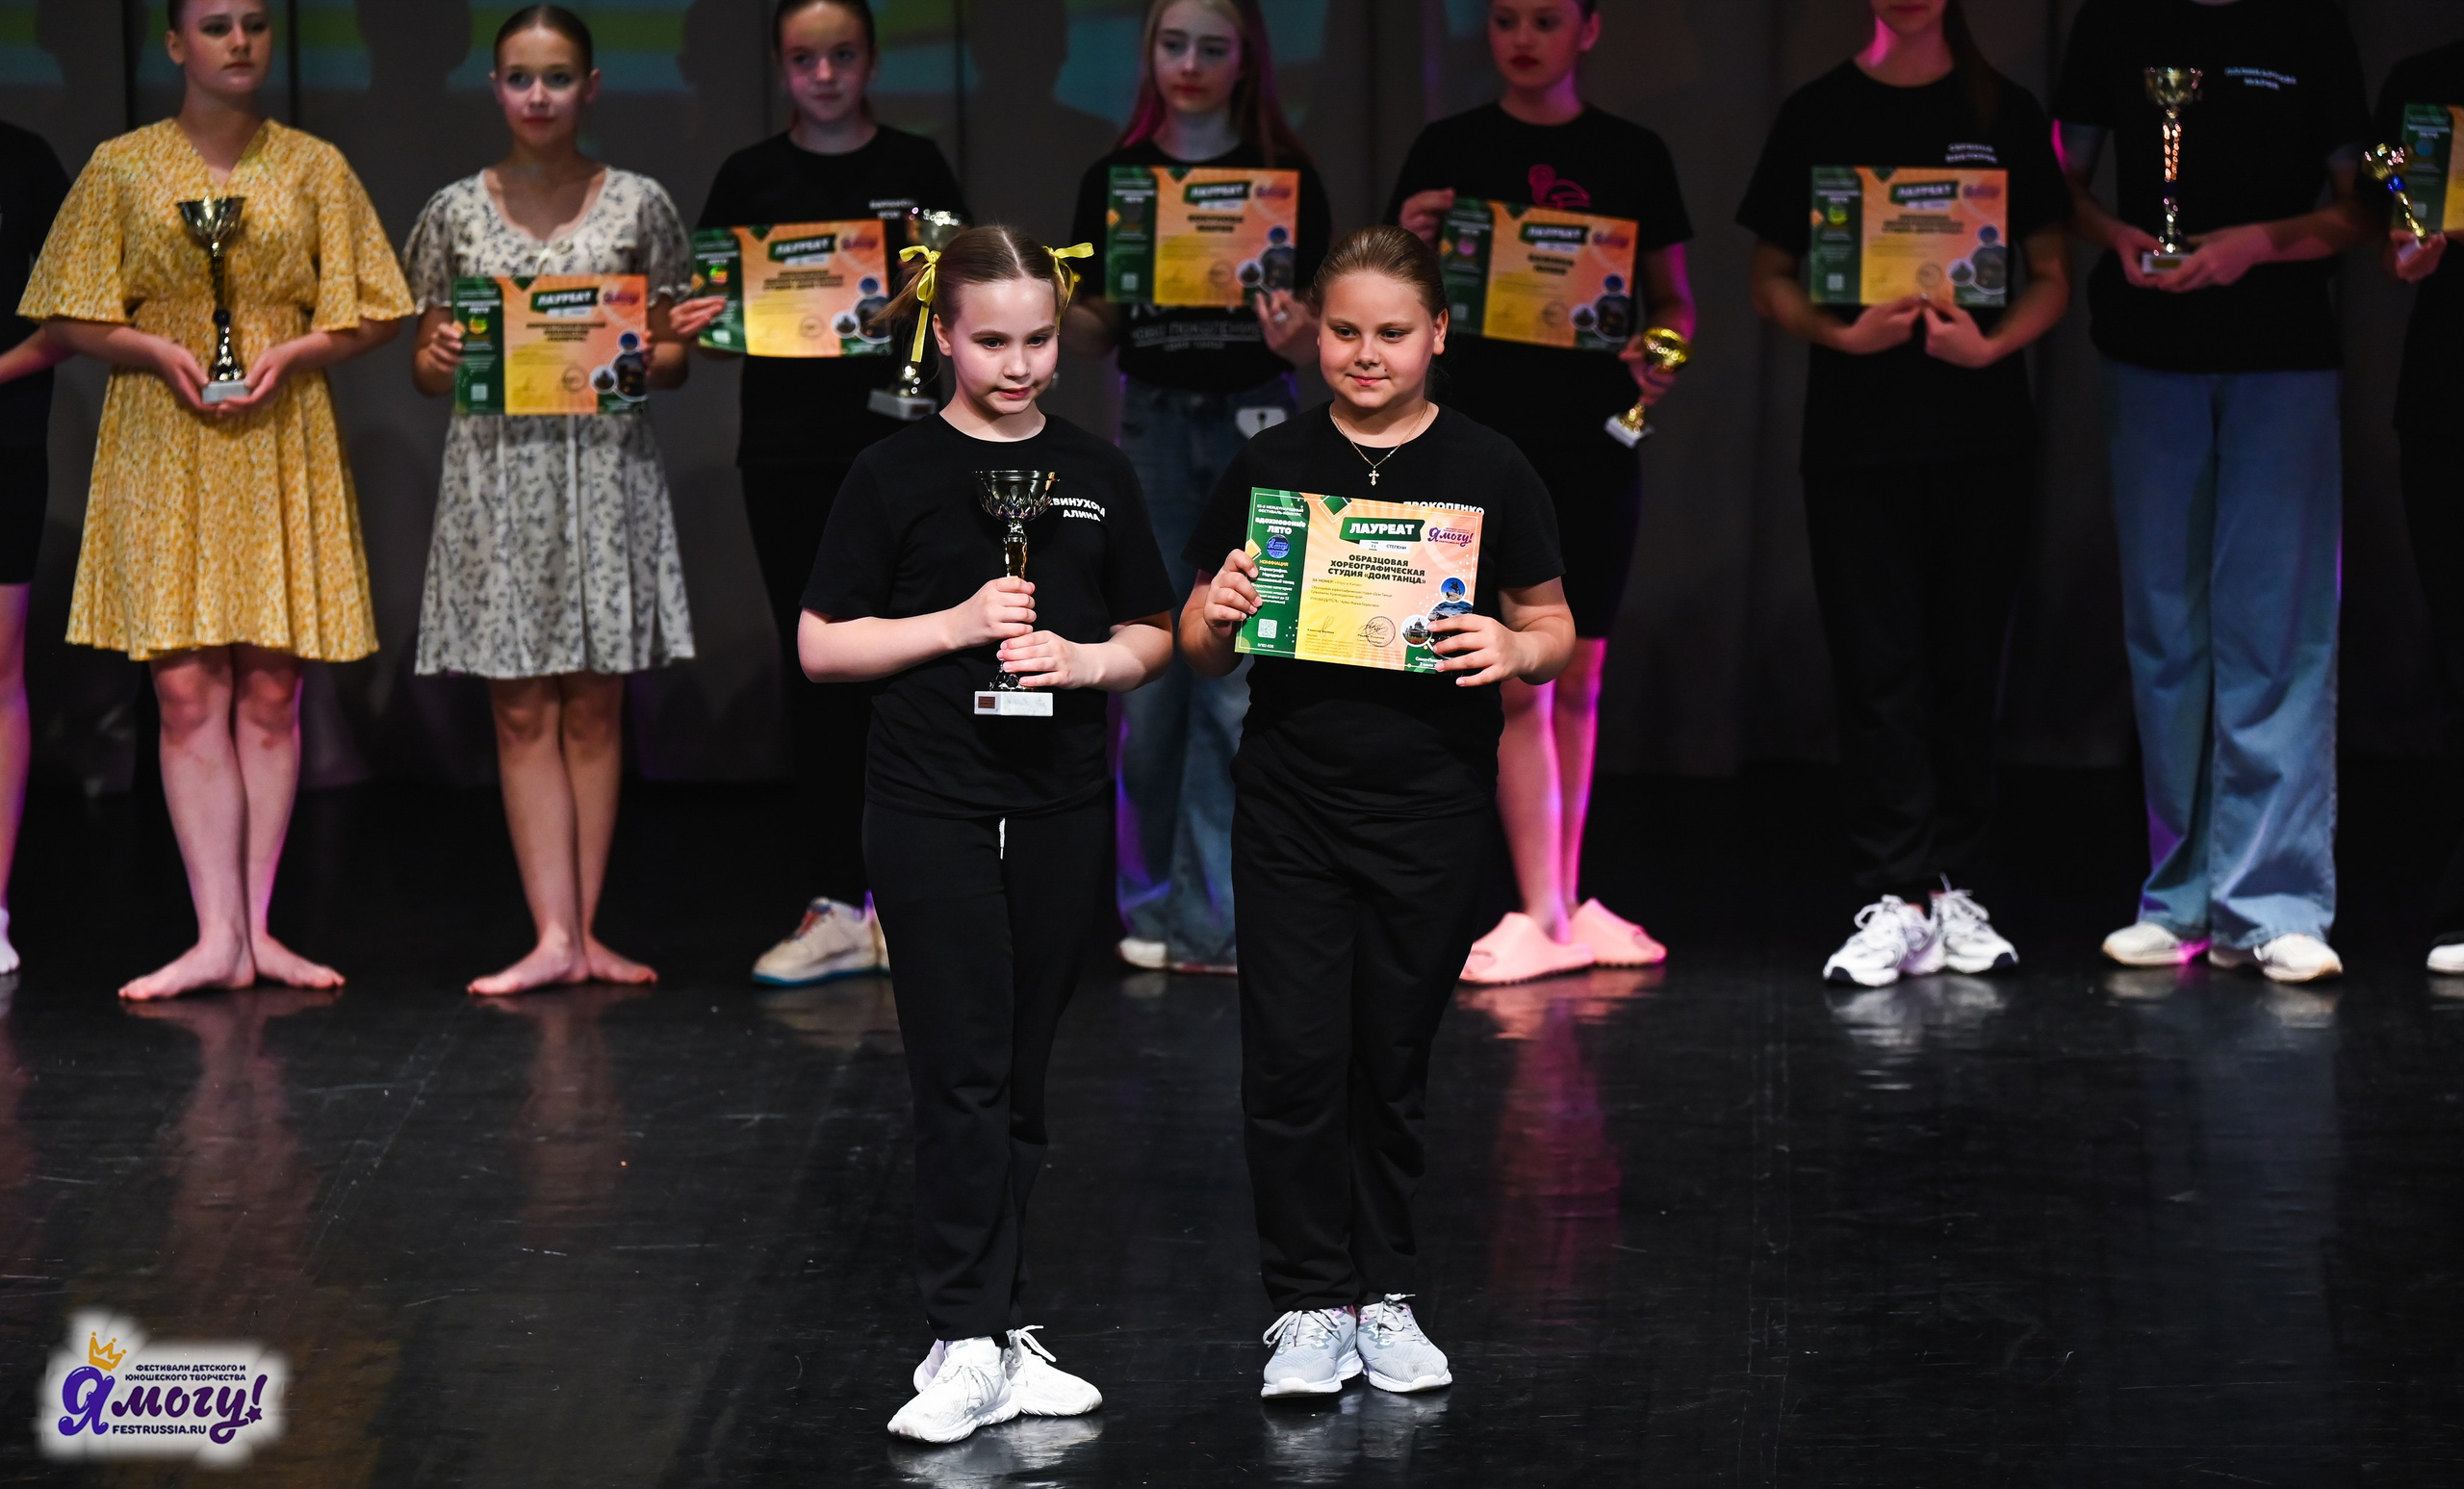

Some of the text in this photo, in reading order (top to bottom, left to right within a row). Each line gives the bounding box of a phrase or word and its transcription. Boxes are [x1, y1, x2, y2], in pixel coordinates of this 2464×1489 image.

[1050, 497, 1106, 518] ВИНУХОА
[1063, 509, 1101, 522] АЛИНА
[1267, 526, 1293, 535] ЛЕТО
[1349, 523, 1415, 535] ЛАУРЕАТ
[1348, 554, 1409, 567] ОБРАЗЦОВАЯ
[1330, 560, 1425, 577] ХОРЕОГРАФИЧЕСКАЯ
[1328, 568, 1426, 584] СТУДИЯ «ДОМ ТАНЦА»
